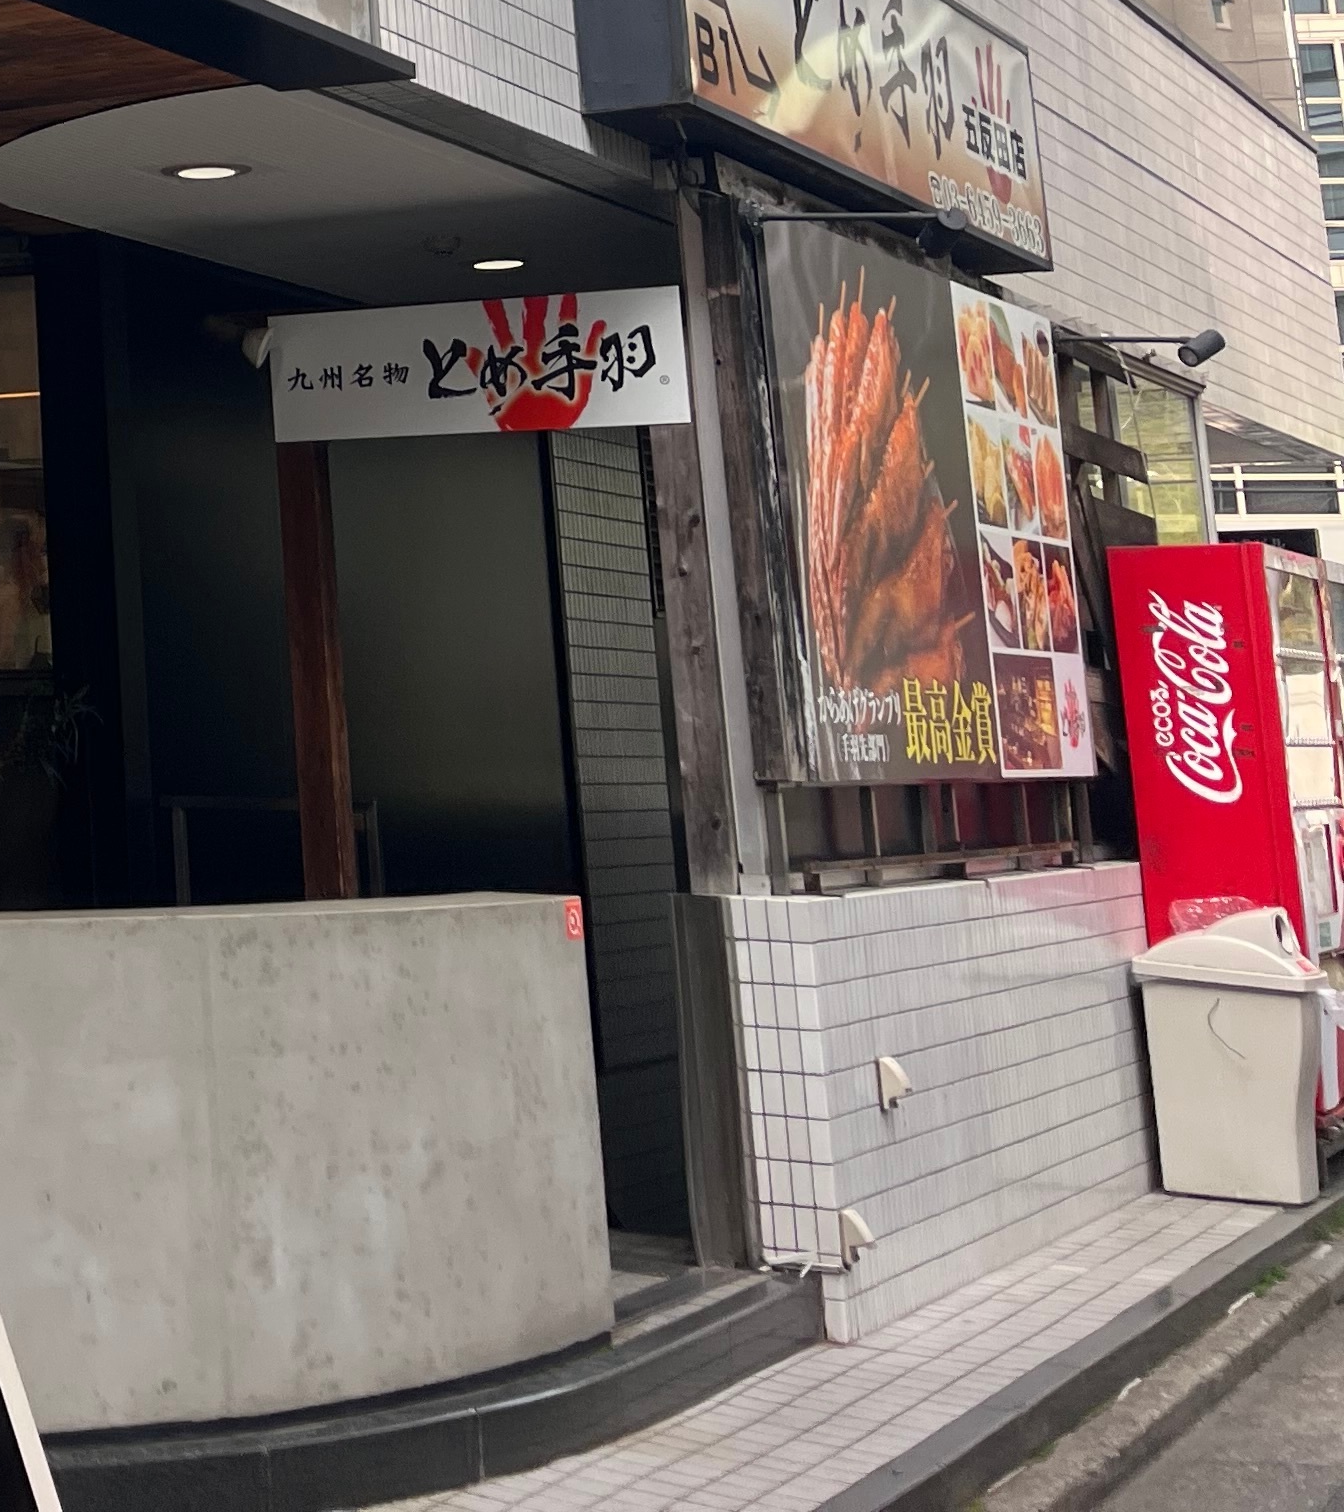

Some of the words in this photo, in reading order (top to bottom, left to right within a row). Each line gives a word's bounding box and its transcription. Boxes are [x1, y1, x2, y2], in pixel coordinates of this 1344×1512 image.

[694, 12, 736, 96] B1
[962, 102, 1027, 181] 五反田店
[287, 364, 410, 393] 九州名物
[423, 323, 658, 416] とめ手羽
[902, 677, 998, 765] 最高金賞
